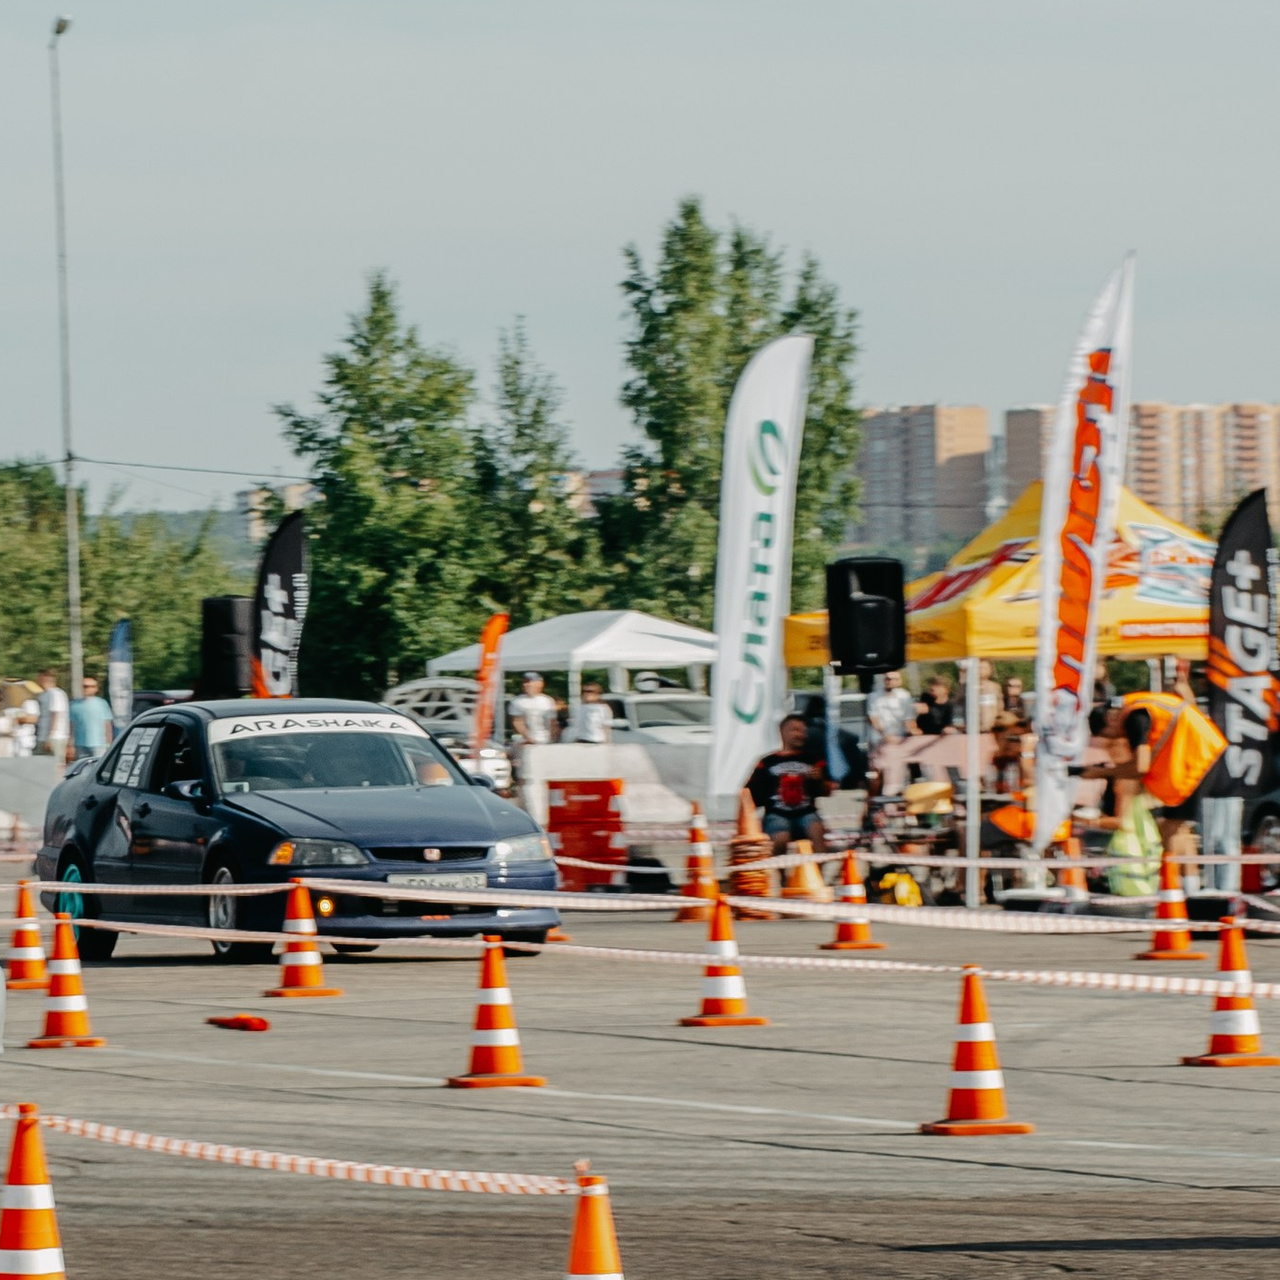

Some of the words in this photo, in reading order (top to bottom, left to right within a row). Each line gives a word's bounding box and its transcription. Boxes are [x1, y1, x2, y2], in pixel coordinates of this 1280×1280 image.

[730, 512, 776, 724] Слата
[1221, 549, 1271, 785] STAGE+
[229, 718, 408, 735] ARASHAIKA
